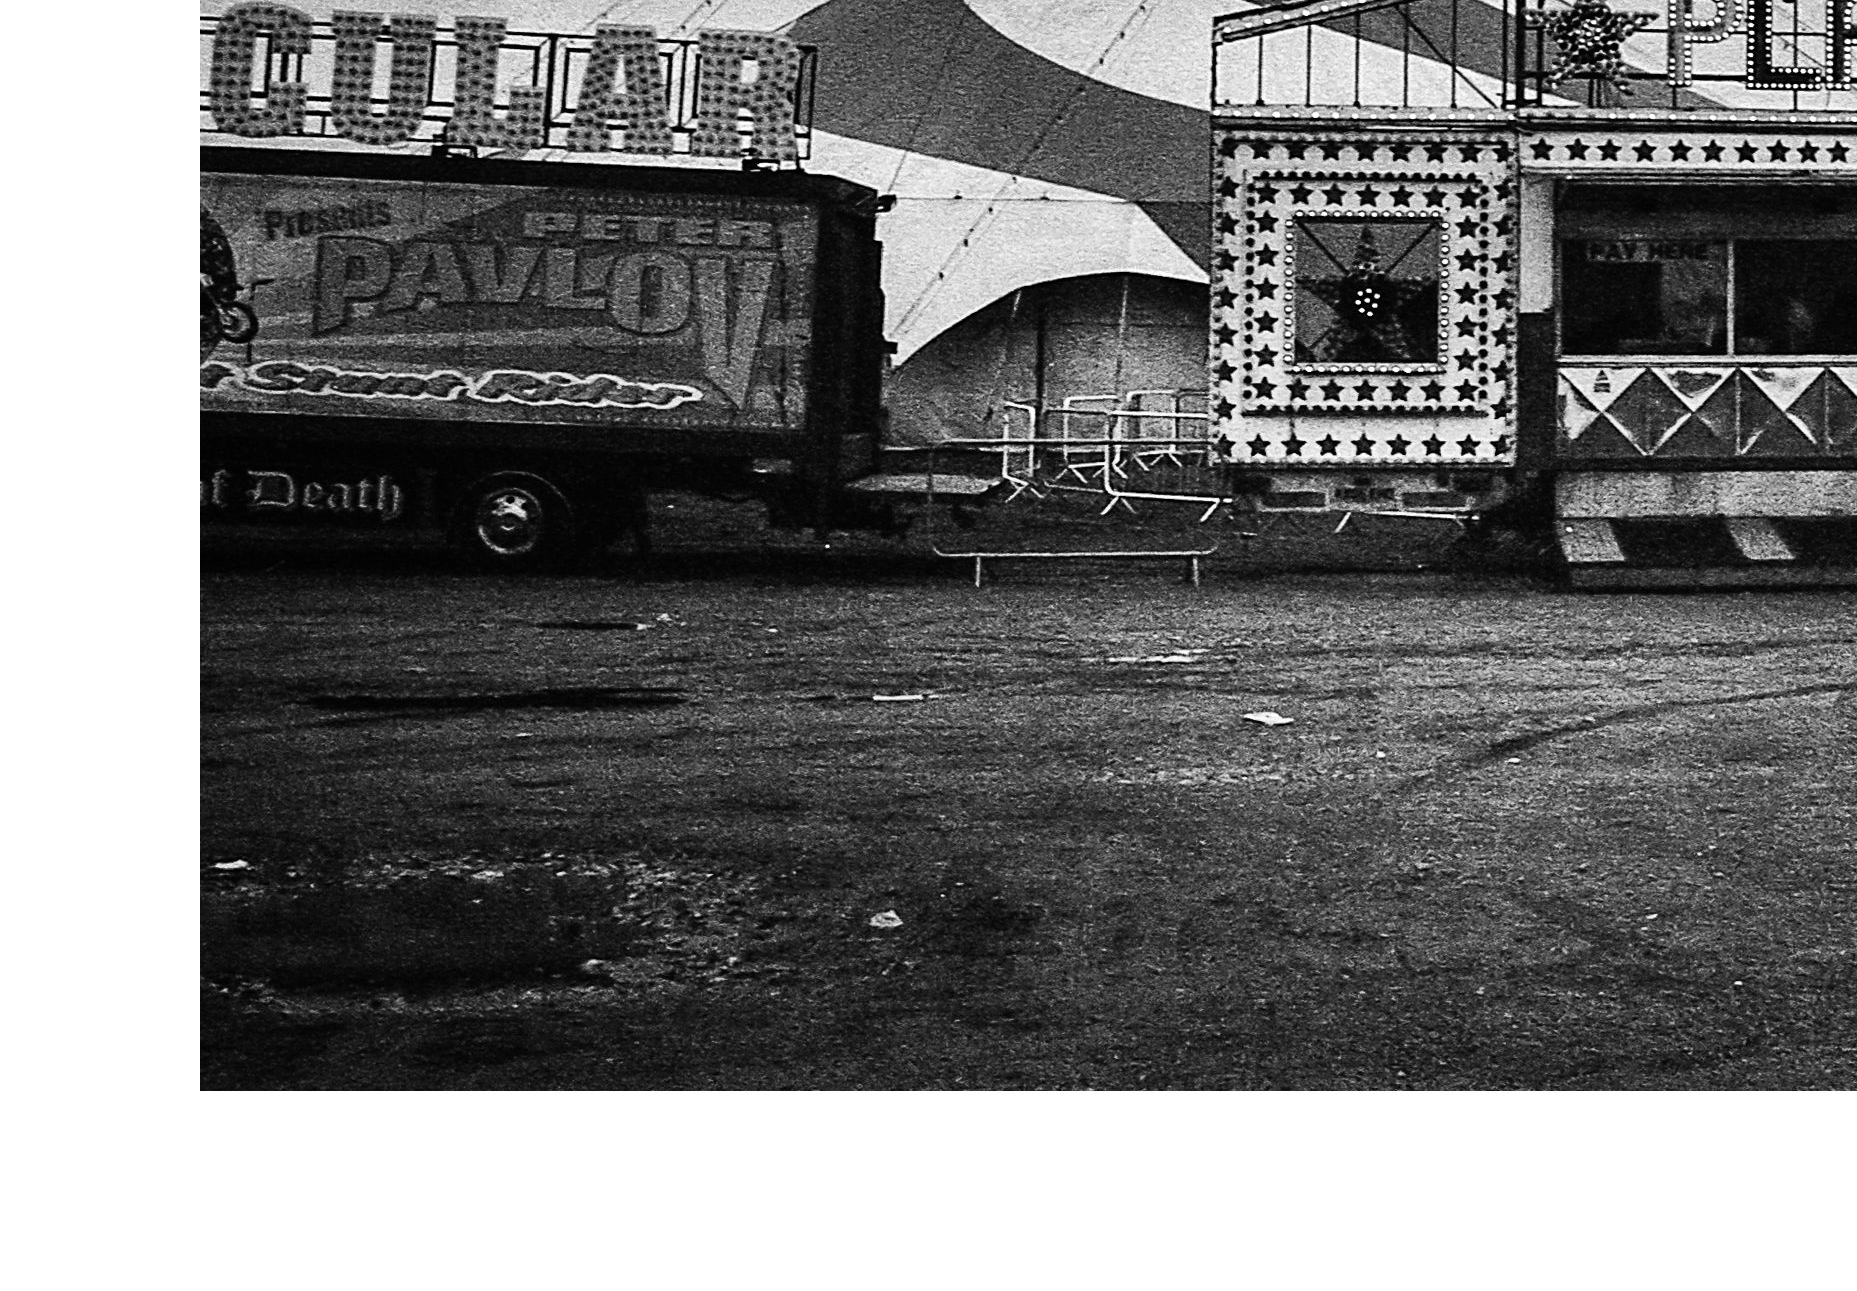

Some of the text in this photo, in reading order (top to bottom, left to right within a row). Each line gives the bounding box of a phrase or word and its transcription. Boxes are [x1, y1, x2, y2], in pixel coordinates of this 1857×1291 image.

[210, 1, 801, 160] CULAR
[523, 212, 773, 250] PETER
[1590, 241, 1708, 261] PAY HERE
[312, 234, 776, 410] PAVLOV
[201, 469, 403, 522] f Death
